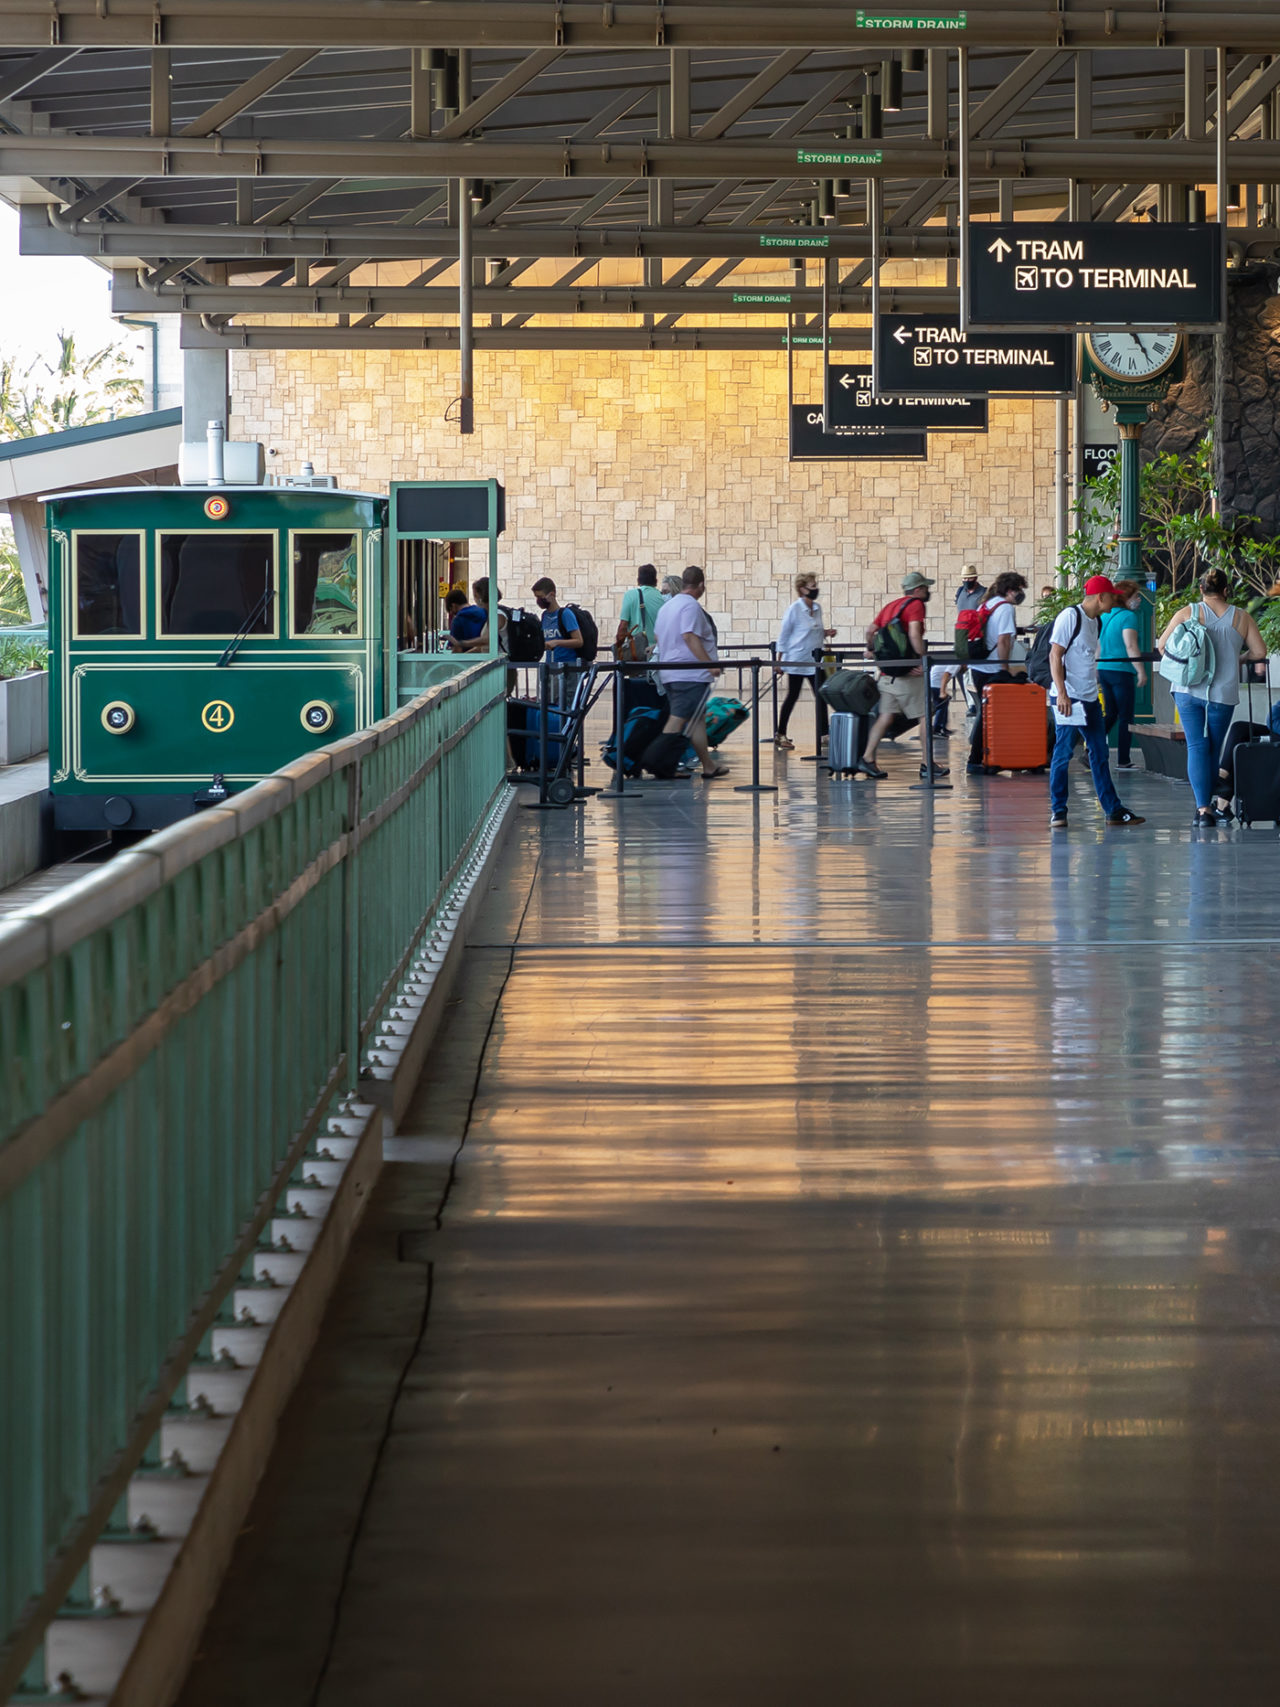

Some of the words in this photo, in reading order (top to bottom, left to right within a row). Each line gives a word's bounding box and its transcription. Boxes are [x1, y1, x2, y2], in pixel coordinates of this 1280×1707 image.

[865, 19, 913, 29] STORM
[917, 20, 959, 29] DRAIN
[804, 154, 841, 163] STORM
[844, 155, 876, 164] DRAIN
[765, 238, 796, 247] STORM
[798, 239, 825, 247] DRAIN
[1016, 240, 1084, 260] TRAM
[1041, 268, 1073, 288] TO
[1078, 268, 1197, 289] TERMINAL
[737, 295, 763, 303] STORM
[764, 295, 788, 303] DRAIN
[914, 327, 967, 343] TRAM
[934, 349, 959, 365] TO
[962, 349, 1055, 365] TERMINAL
[1084, 448, 1117, 460] FLOO
[208, 704, 225, 727] 4
